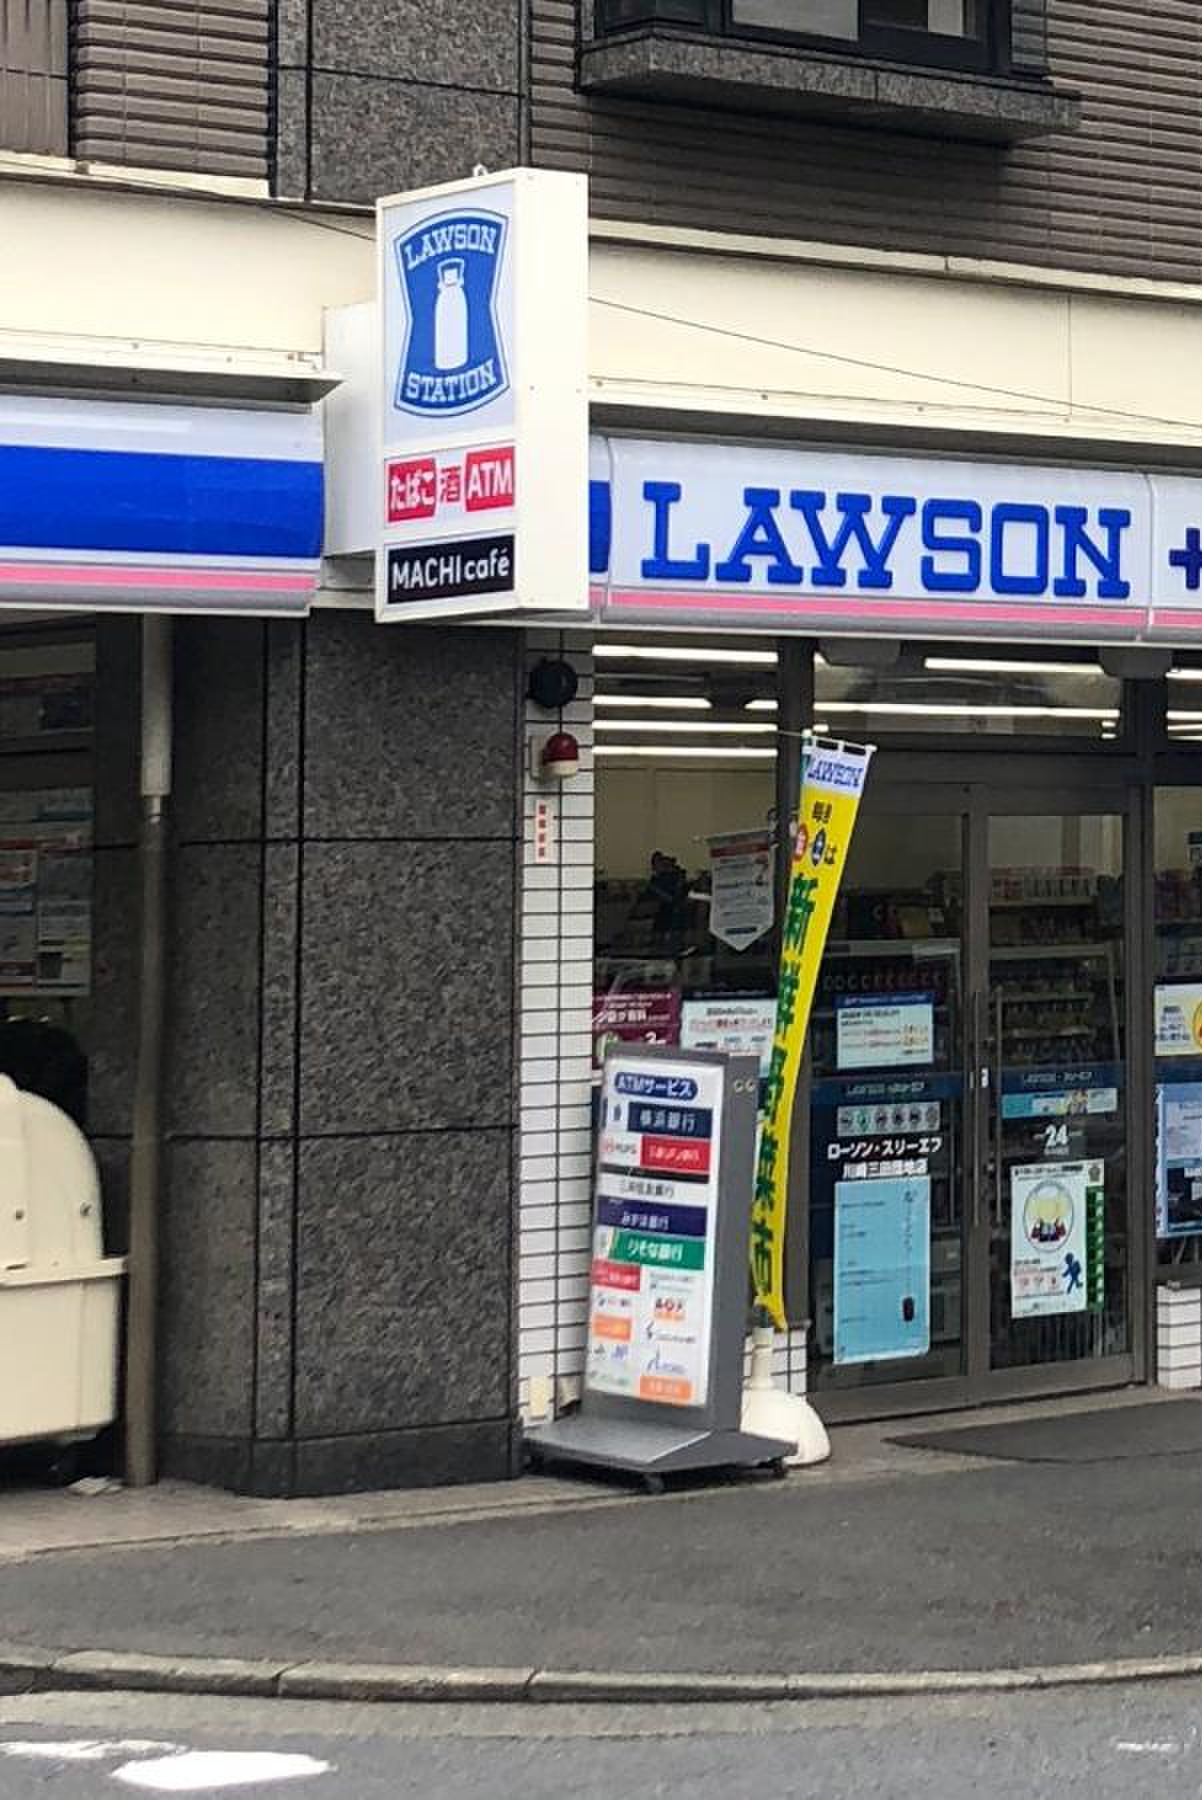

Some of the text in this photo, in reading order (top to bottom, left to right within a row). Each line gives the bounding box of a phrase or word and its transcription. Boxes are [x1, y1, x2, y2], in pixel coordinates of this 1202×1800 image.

[405, 223, 497, 271] LAWSON
[405, 359, 497, 402] STATION
[390, 459, 513, 512] たばこ 酒 ATM
[641, 480, 1131, 600] LAWSON
[391, 546, 511, 591] MACHI café
[617, 1073, 693, 1099] ATMサービス
[828, 1137, 942, 1160] ローソン・スリーエフ
